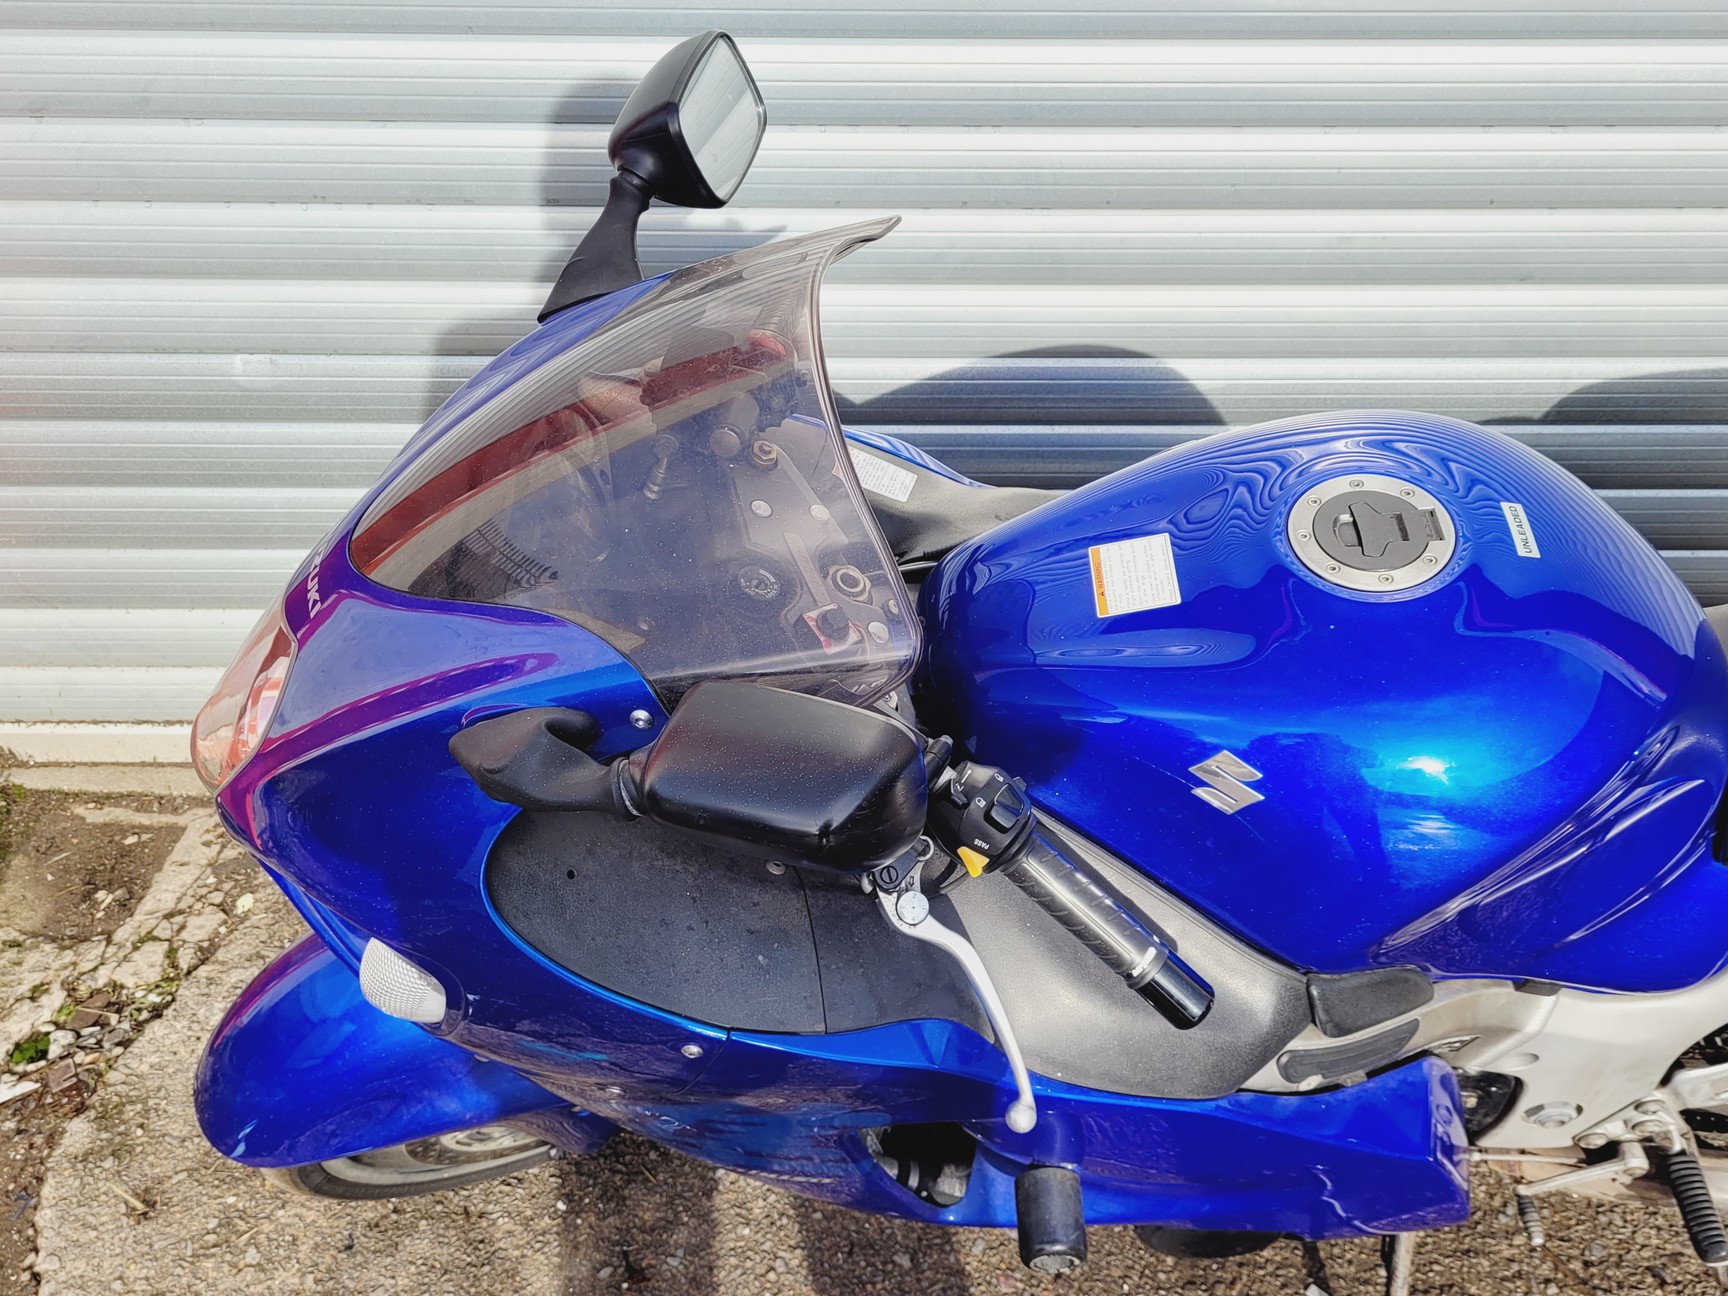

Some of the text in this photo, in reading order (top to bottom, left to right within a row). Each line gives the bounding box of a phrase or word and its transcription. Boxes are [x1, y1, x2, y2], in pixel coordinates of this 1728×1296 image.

[1508, 505, 1533, 554] UNLEADED
[1095, 562, 1104, 590] WARNING
[973, 838, 990, 850] PASS
